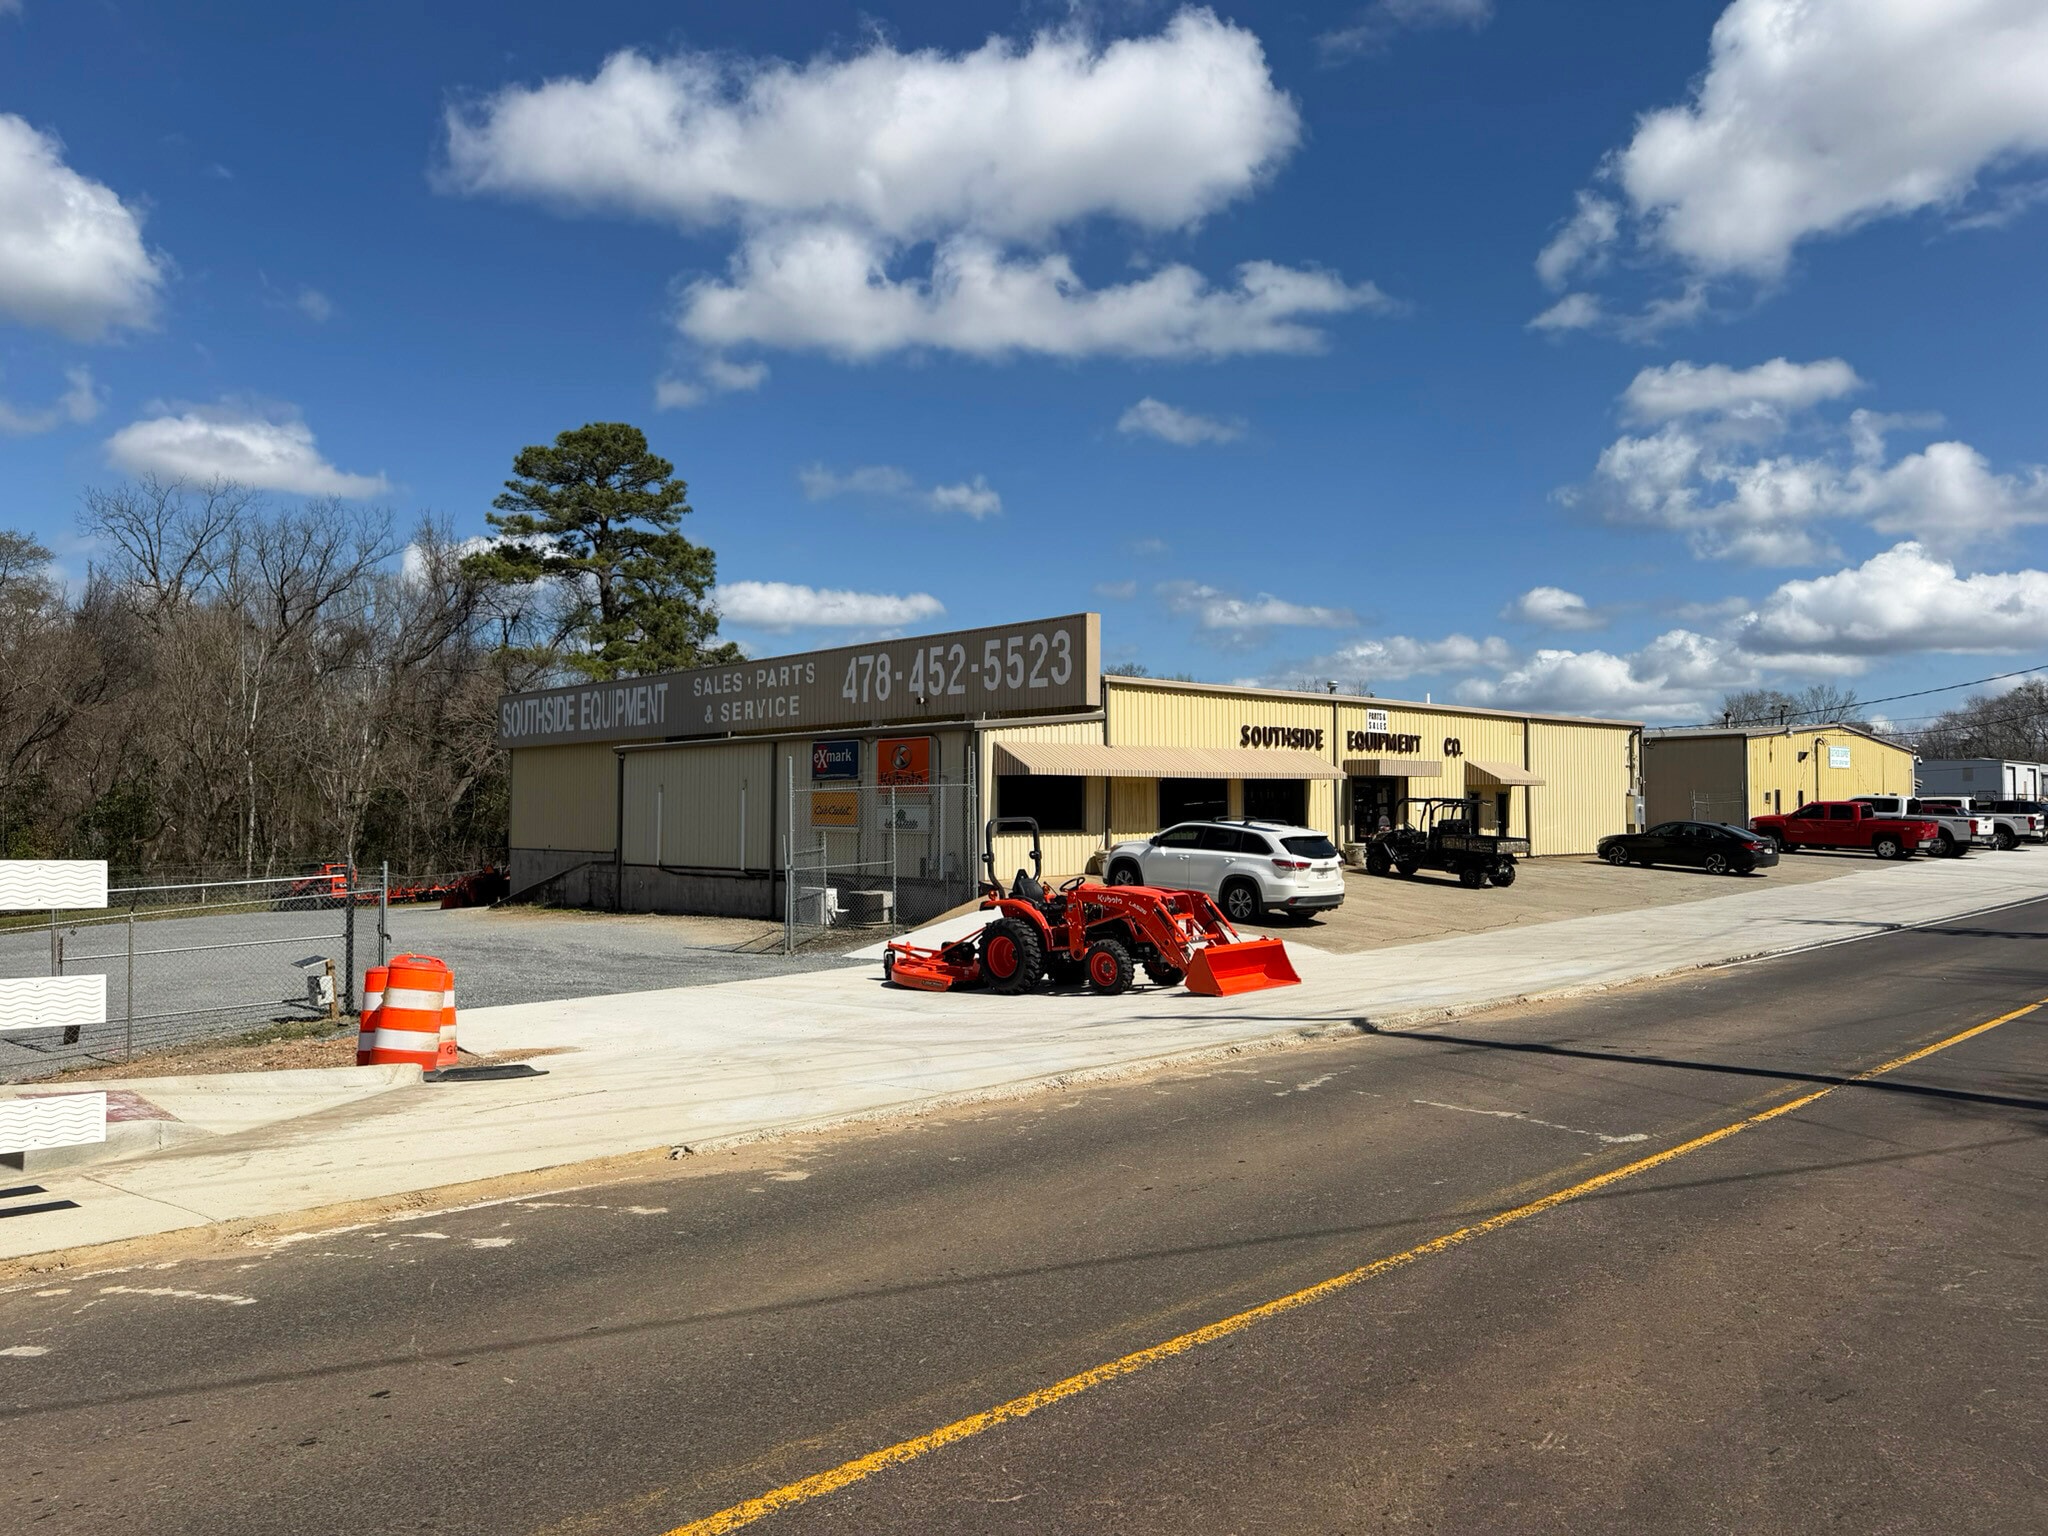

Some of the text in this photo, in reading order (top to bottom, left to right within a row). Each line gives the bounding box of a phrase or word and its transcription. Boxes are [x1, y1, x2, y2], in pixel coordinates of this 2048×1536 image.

[693, 662, 815, 697] SALES PARTS
[502, 682, 669, 738] SOUTHSIDE EQUIPMENT
[704, 695, 800, 724] & SERVICE
[1368, 711, 1382, 721] PARTS
[1240, 724, 1464, 757] SOUTHSIDE EQUIPMENT CO.
[1368, 721, 1387, 731] SALES
[1097, 894, 1123, 905] Kubota
